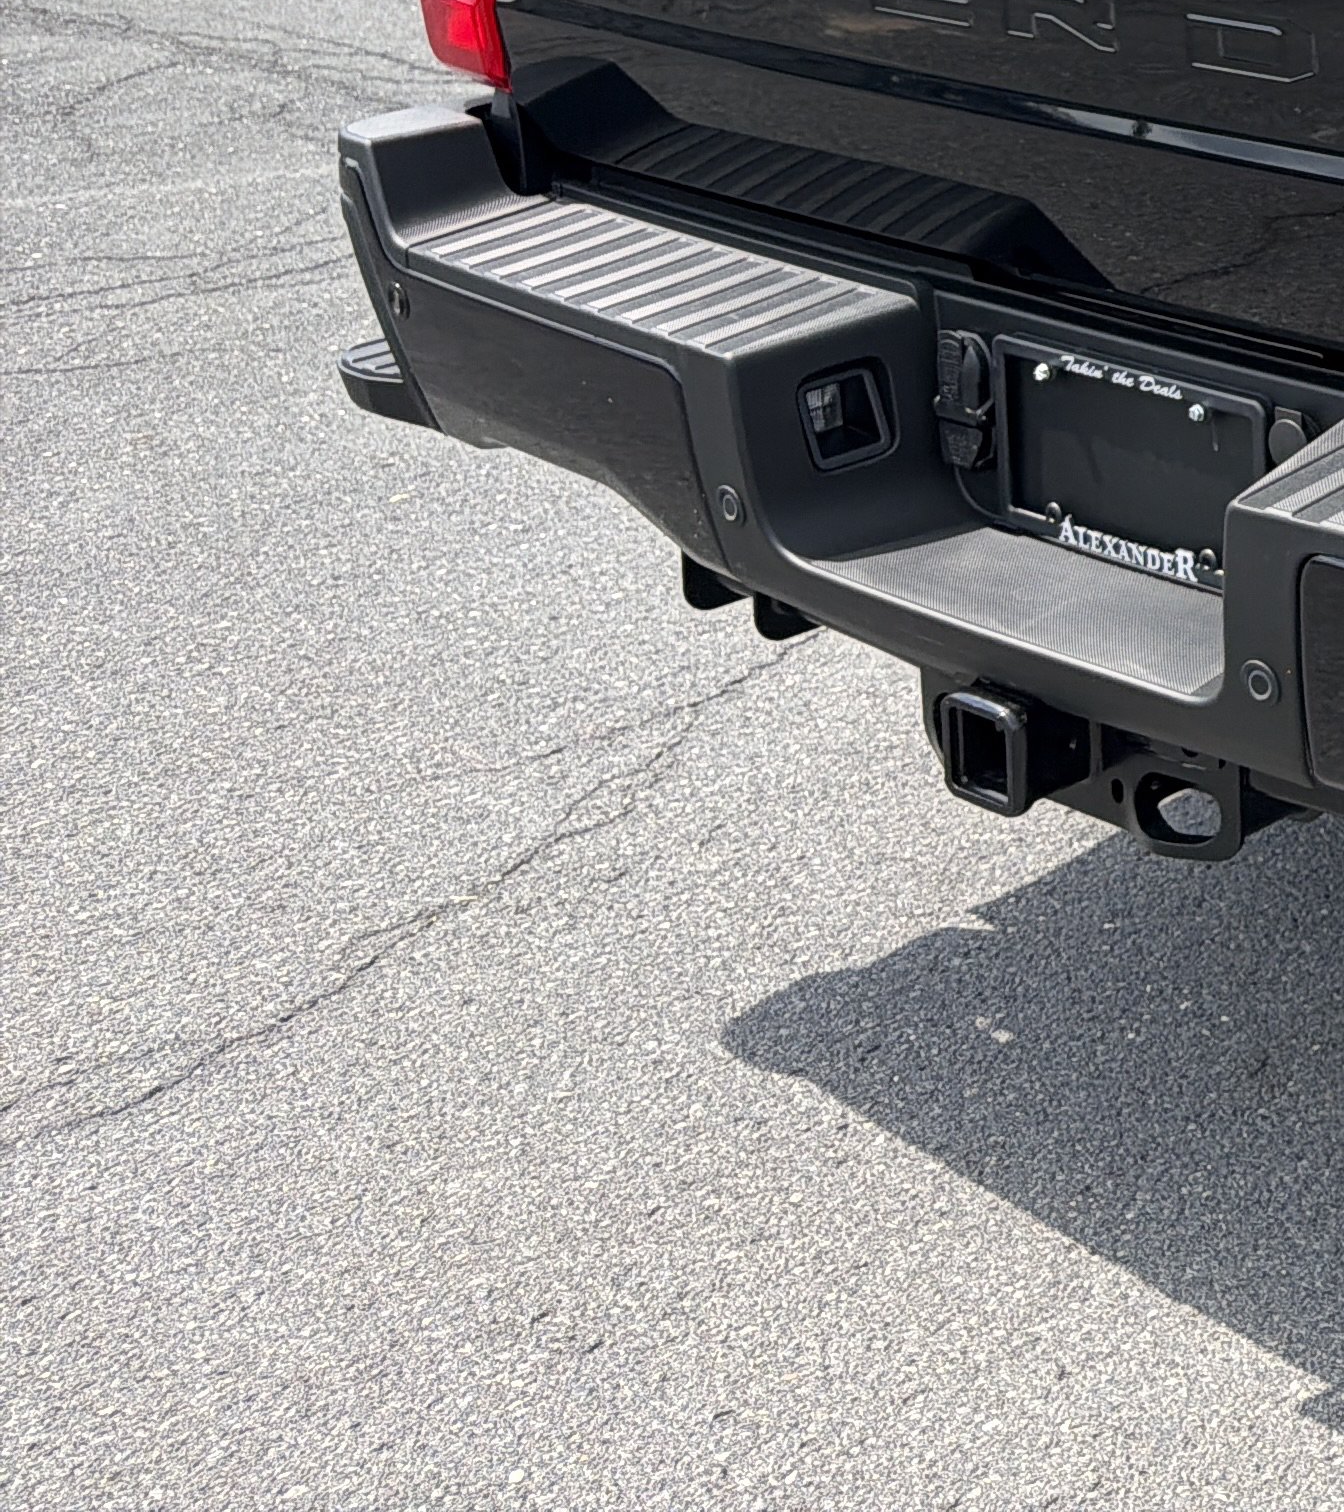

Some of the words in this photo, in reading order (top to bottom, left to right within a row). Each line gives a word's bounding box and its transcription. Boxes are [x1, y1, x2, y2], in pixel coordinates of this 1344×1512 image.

[1060, 354, 1108, 379] Takin'
[1111, 370, 1135, 388] the
[1138, 375, 1183, 400] Deals
[1058, 513, 1199, 583] ALEXANDER
